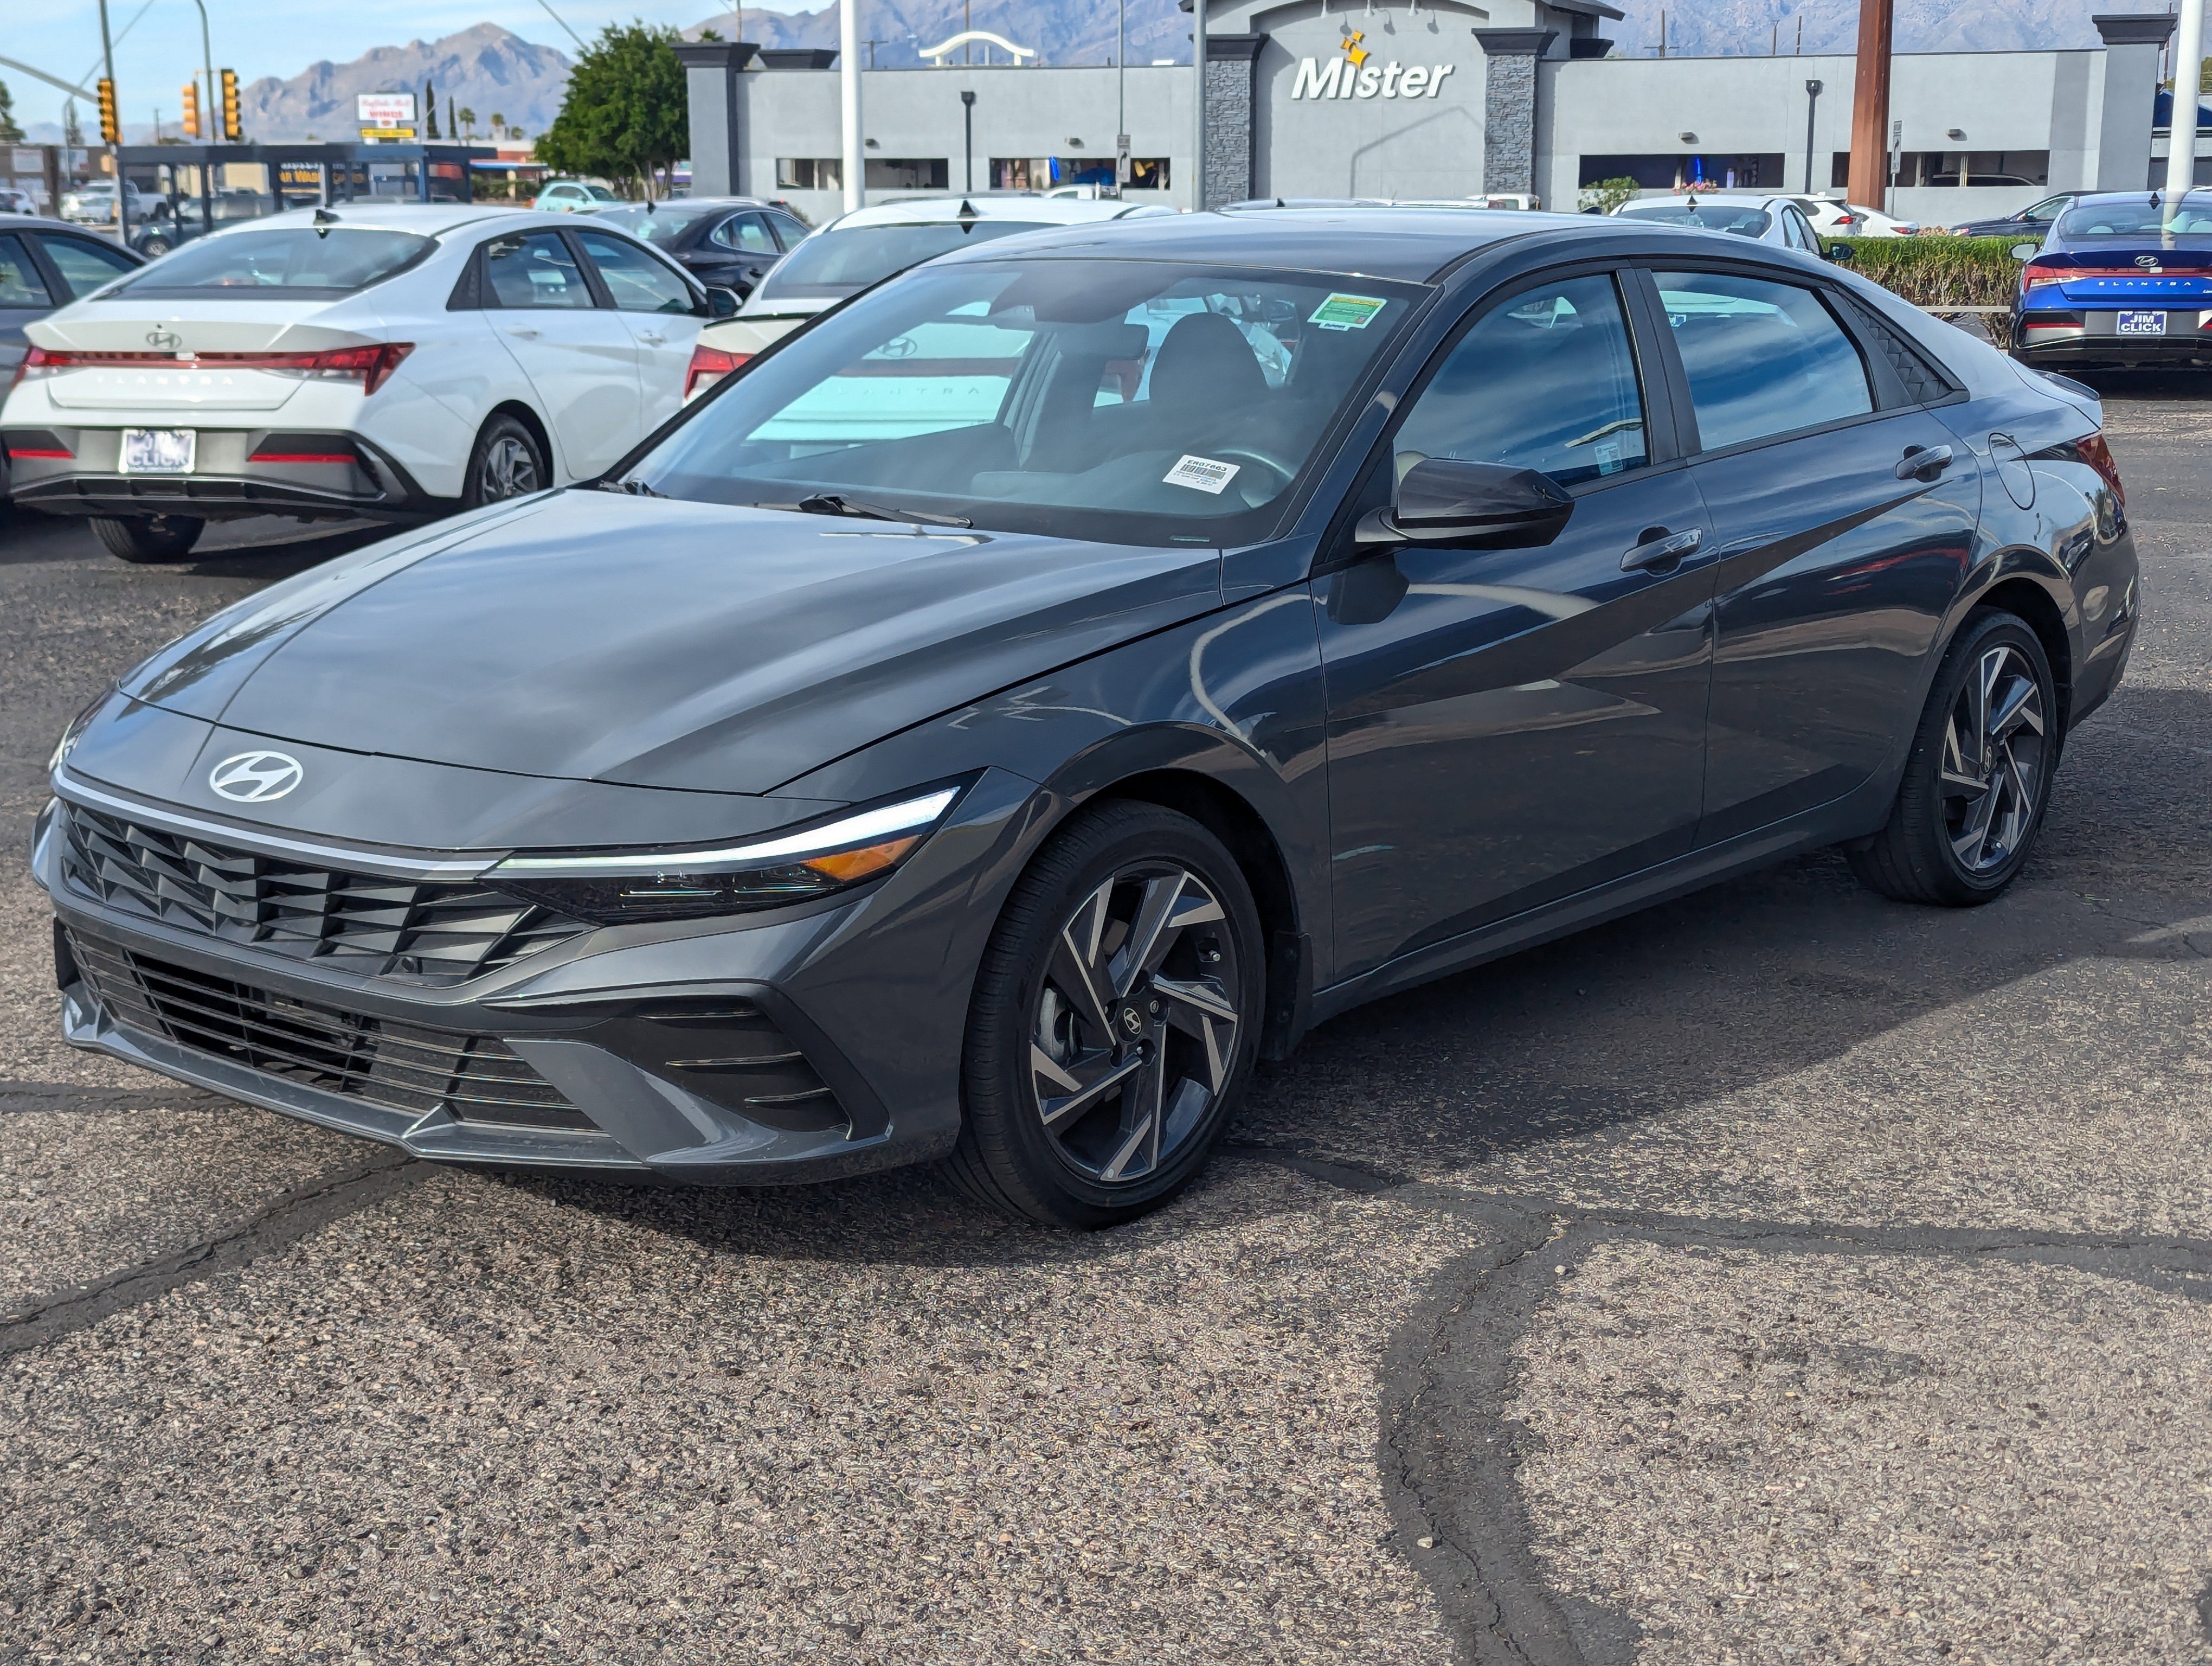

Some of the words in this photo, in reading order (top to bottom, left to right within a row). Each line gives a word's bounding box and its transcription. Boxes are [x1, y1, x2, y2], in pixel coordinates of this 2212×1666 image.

[1291, 56, 1455, 99] Mister
[2130, 315, 2155, 323] JIM
[2120, 323, 2162, 332] CLICK
